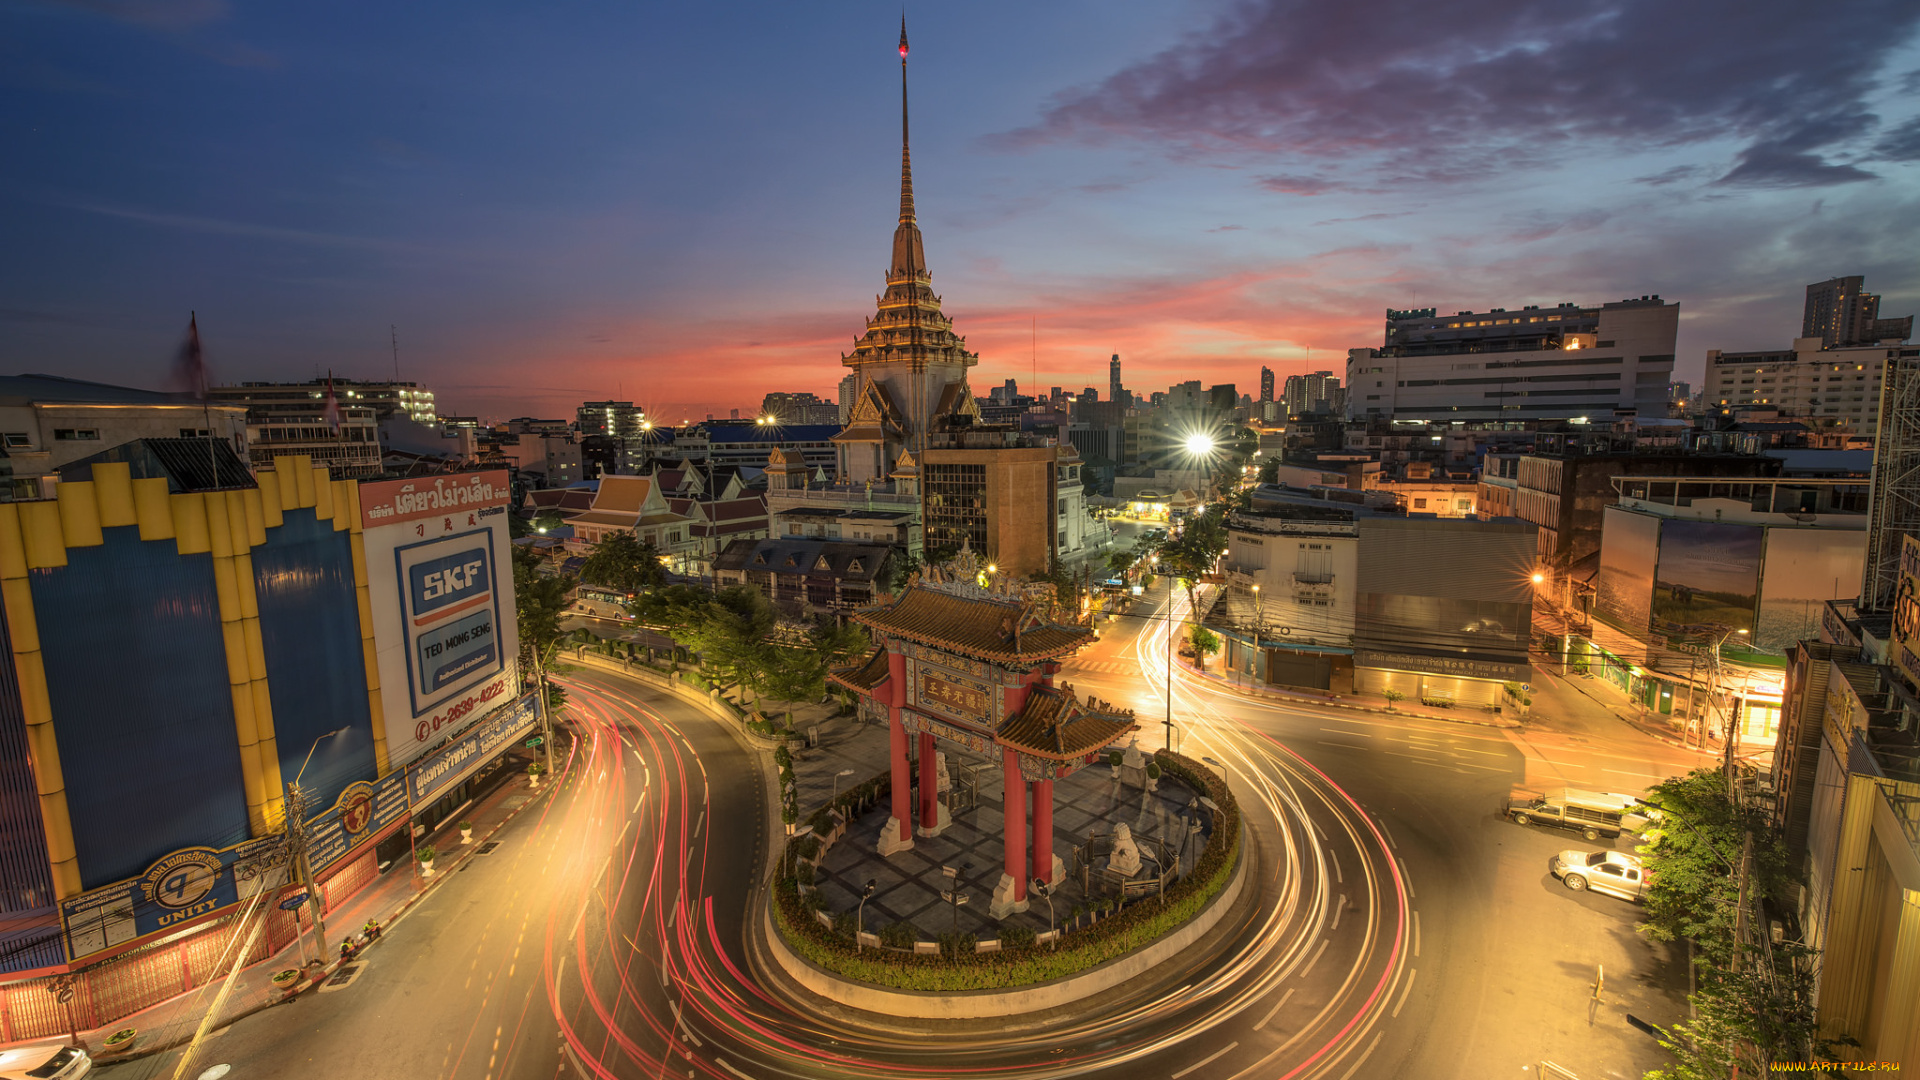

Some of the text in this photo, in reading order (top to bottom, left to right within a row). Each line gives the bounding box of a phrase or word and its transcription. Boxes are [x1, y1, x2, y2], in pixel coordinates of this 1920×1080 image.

[367, 504, 395, 519] บริษัท
[424, 560, 482, 601] SKF
[424, 622, 491, 659] TEO MONG SENG
[432, 679, 505, 731] 0-2639-4222
[157, 897, 218, 926] UNITY
